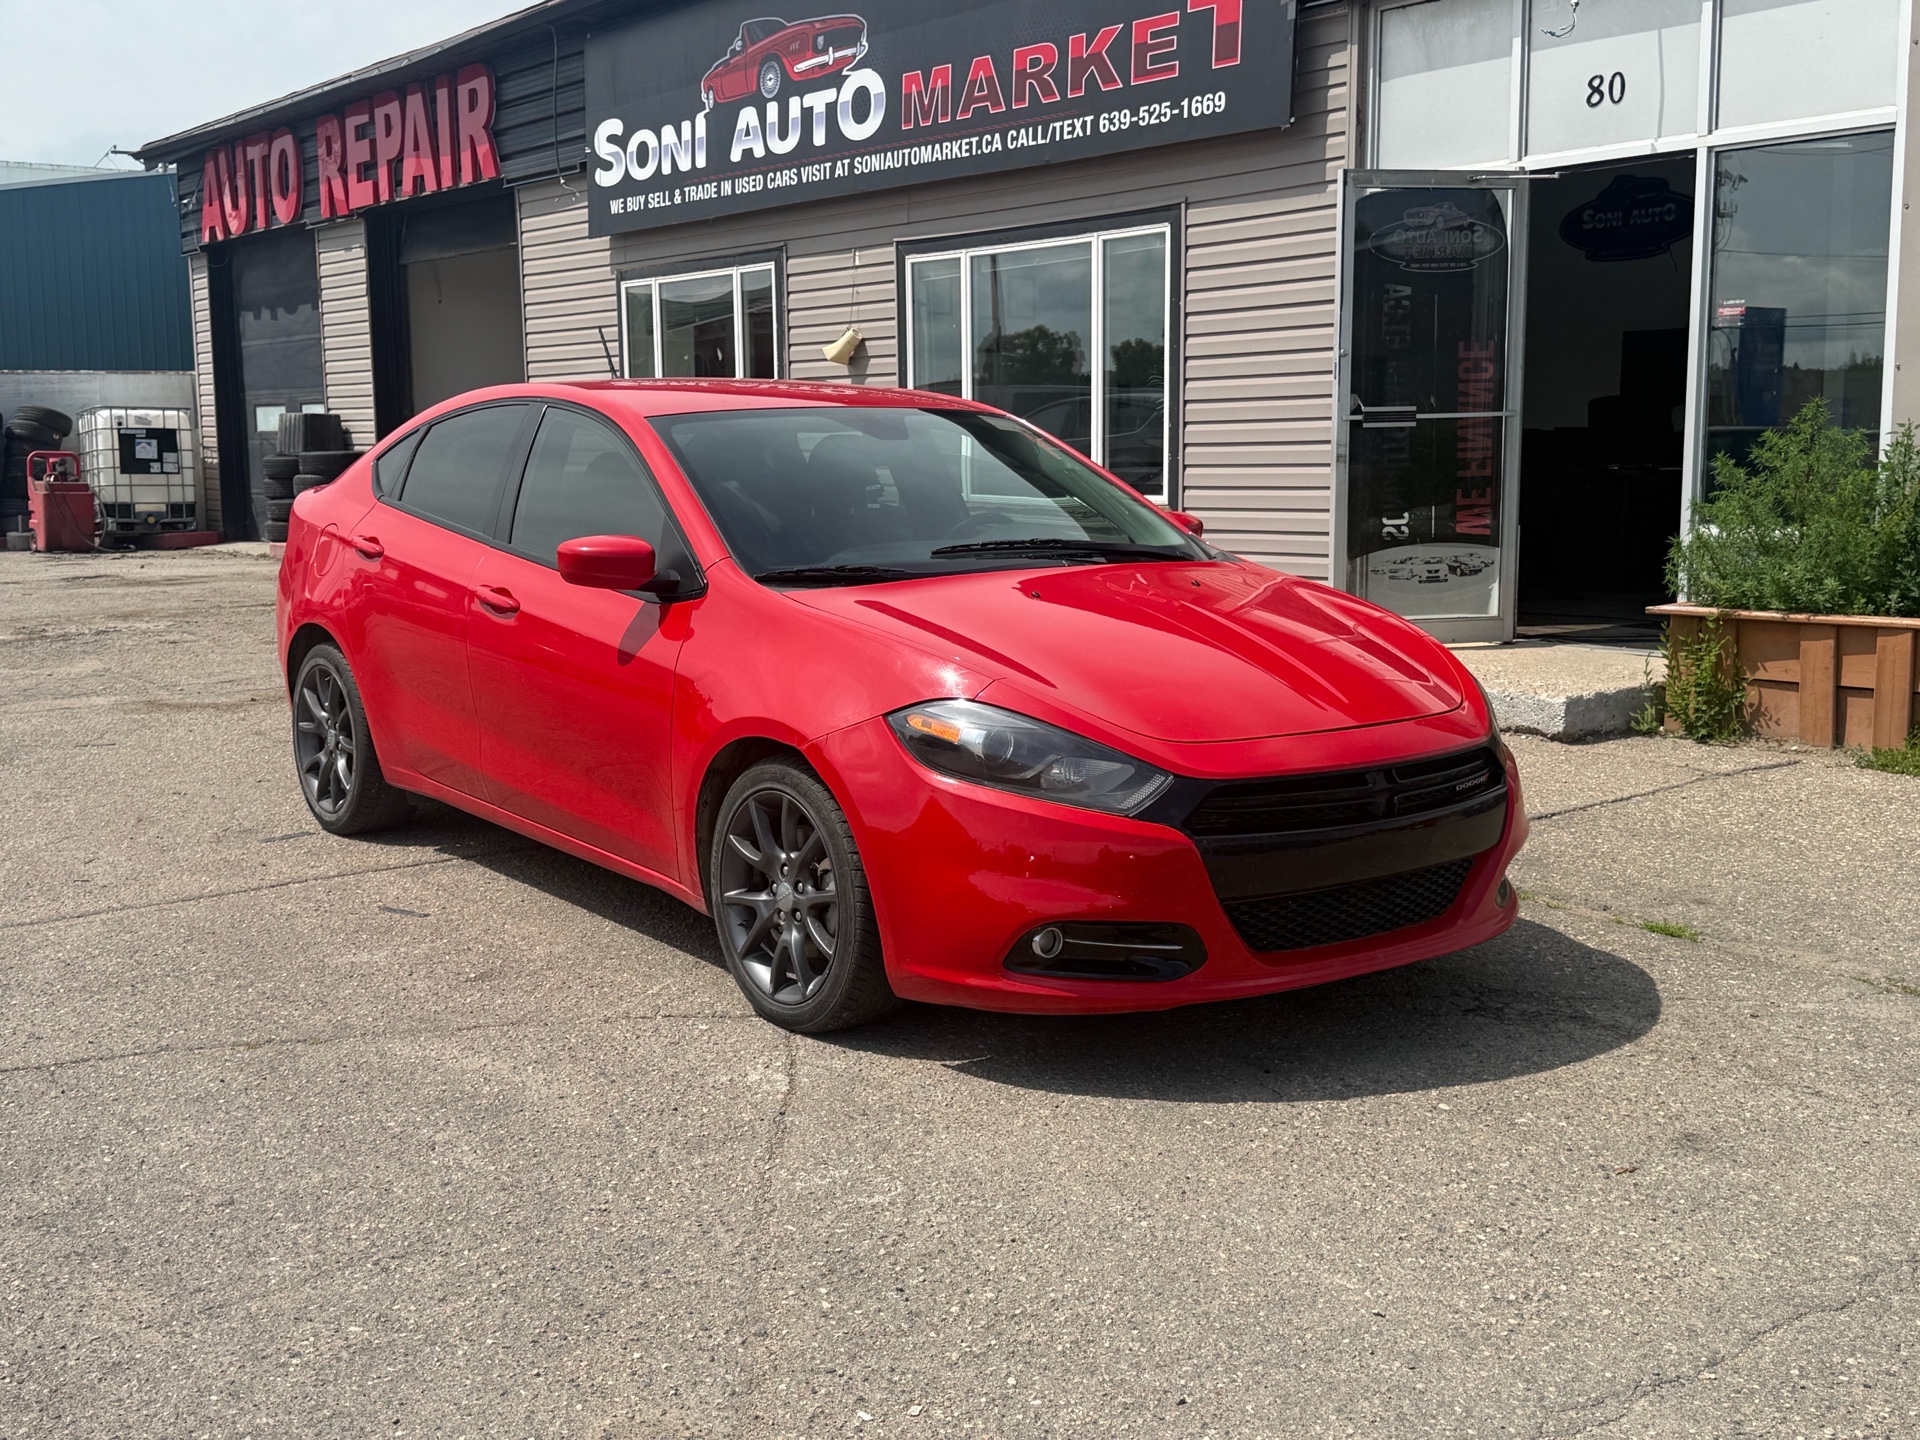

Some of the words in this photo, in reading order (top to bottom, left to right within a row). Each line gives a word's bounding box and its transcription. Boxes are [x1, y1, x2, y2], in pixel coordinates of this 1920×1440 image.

[730, 68, 886, 163] AUTO
[902, 0, 1243, 130] MARKET
[1586, 71, 1626, 108] 80
[202, 126, 303, 243] AUTO
[316, 63, 500, 219] REPAIR
[610, 198, 625, 215] WE
[627, 194, 646, 212] BUY
[648, 191, 671, 210] SELL
[674, 189, 682, 204] &
[684, 183, 718, 202] TRADE
[721, 180, 732, 196] IN
[735, 175, 764, 195] USED
[767, 168, 798, 189] CARS
[801, 162, 831, 184] VISIT
[834, 159, 851, 178] AT
[853, 133, 1003, 175] SONIAUTOMARKET.CA
[1007, 115, 1095, 150] CALL/TEXT
[1099, 91, 1226, 134] 639-525-1669
[1630, 203, 1677, 225] AUTO
[1456, 777, 1484, 791] DODGE
